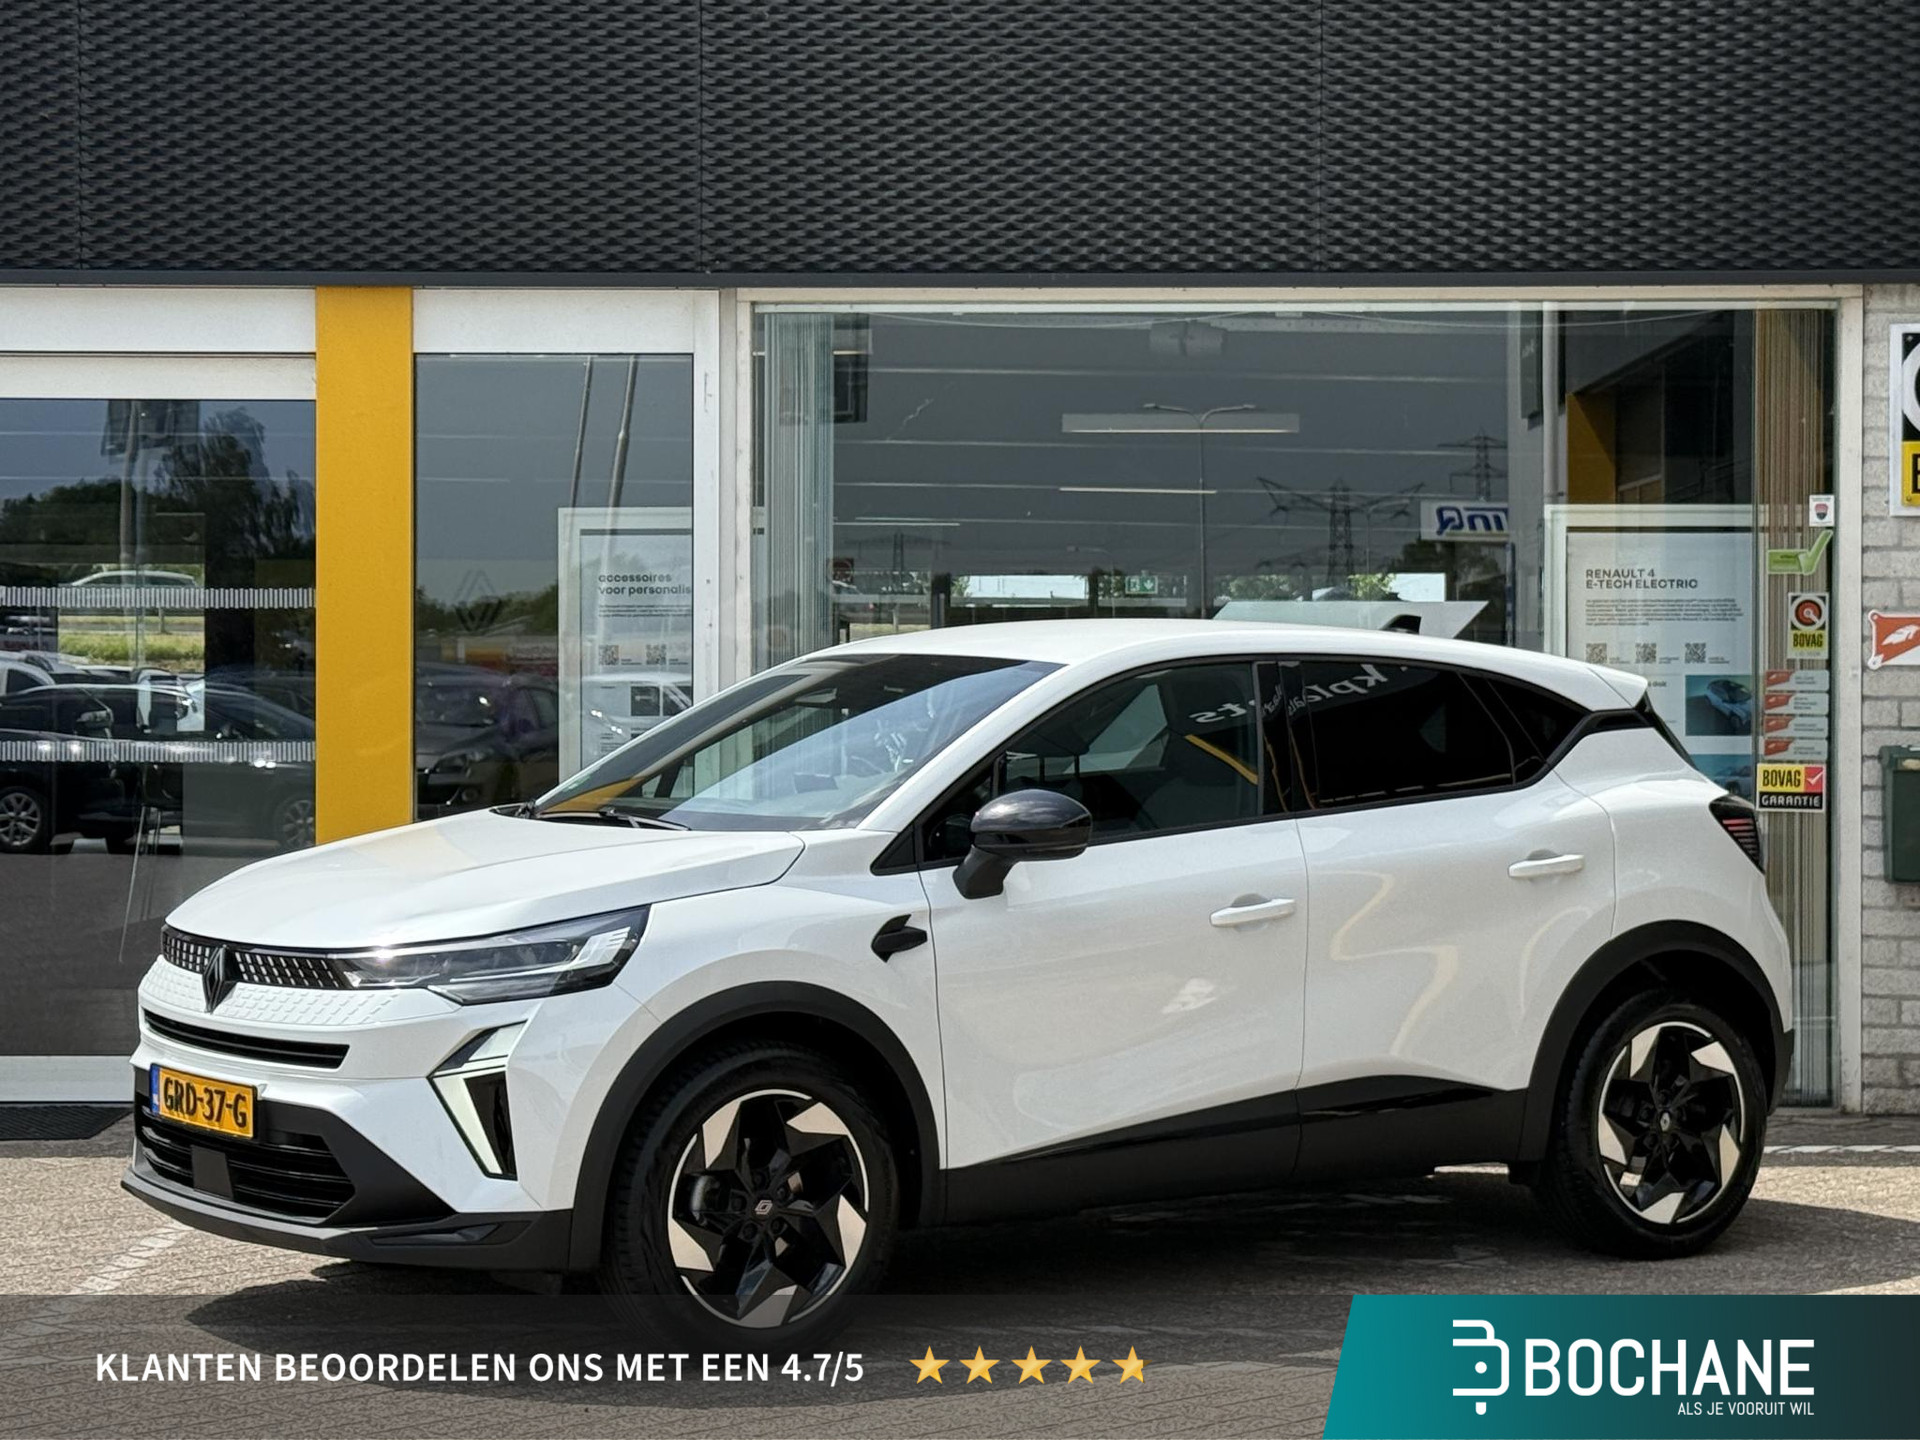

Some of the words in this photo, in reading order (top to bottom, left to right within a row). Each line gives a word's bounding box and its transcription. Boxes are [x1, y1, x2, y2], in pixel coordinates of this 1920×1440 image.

[598, 572, 672, 583] accessoires
[1586, 568, 1646, 579] RENAULT
[1647, 568, 1655, 578] 4
[1586, 579, 1633, 589] E-TECH
[1635, 579, 1698, 589] ELECTRIC
[598, 586, 626, 595] voor
[1793, 633, 1824, 648] BOVAG
[1762, 769, 1801, 787] BOVAG
[1761, 794, 1821, 808] GARANTIE
[163, 1076, 248, 1128] GRD-37-G
